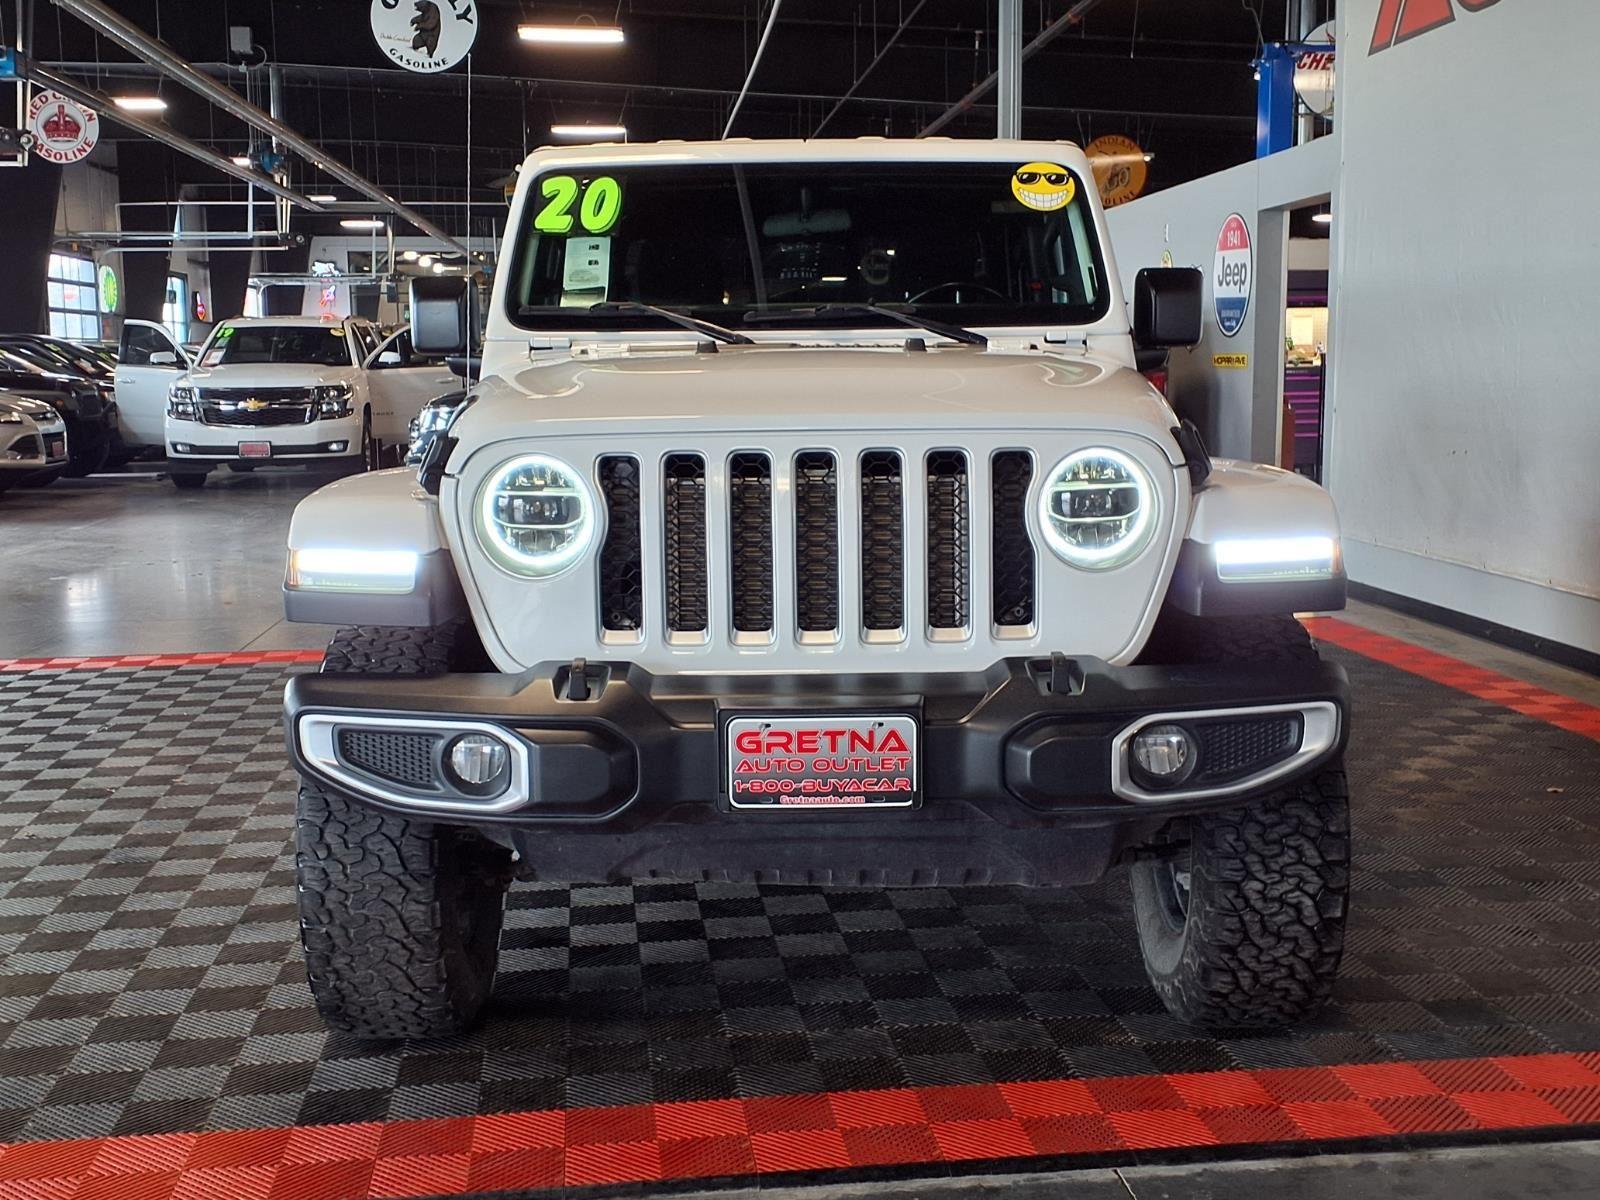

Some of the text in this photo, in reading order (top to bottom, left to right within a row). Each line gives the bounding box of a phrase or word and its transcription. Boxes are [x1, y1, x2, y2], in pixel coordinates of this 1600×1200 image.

[389, 48, 449, 69] GASOLINE
[534, 175, 622, 233] 20
[1227, 230, 1241, 248] 1941
[1217, 255, 1248, 293] Jeep
[216, 327, 235, 338] 19
[734, 729, 912, 754] GRETNA
[734, 756, 912, 774] AUTO OUTLET
[734, 777, 912, 793] 1-800-BUYACAR
